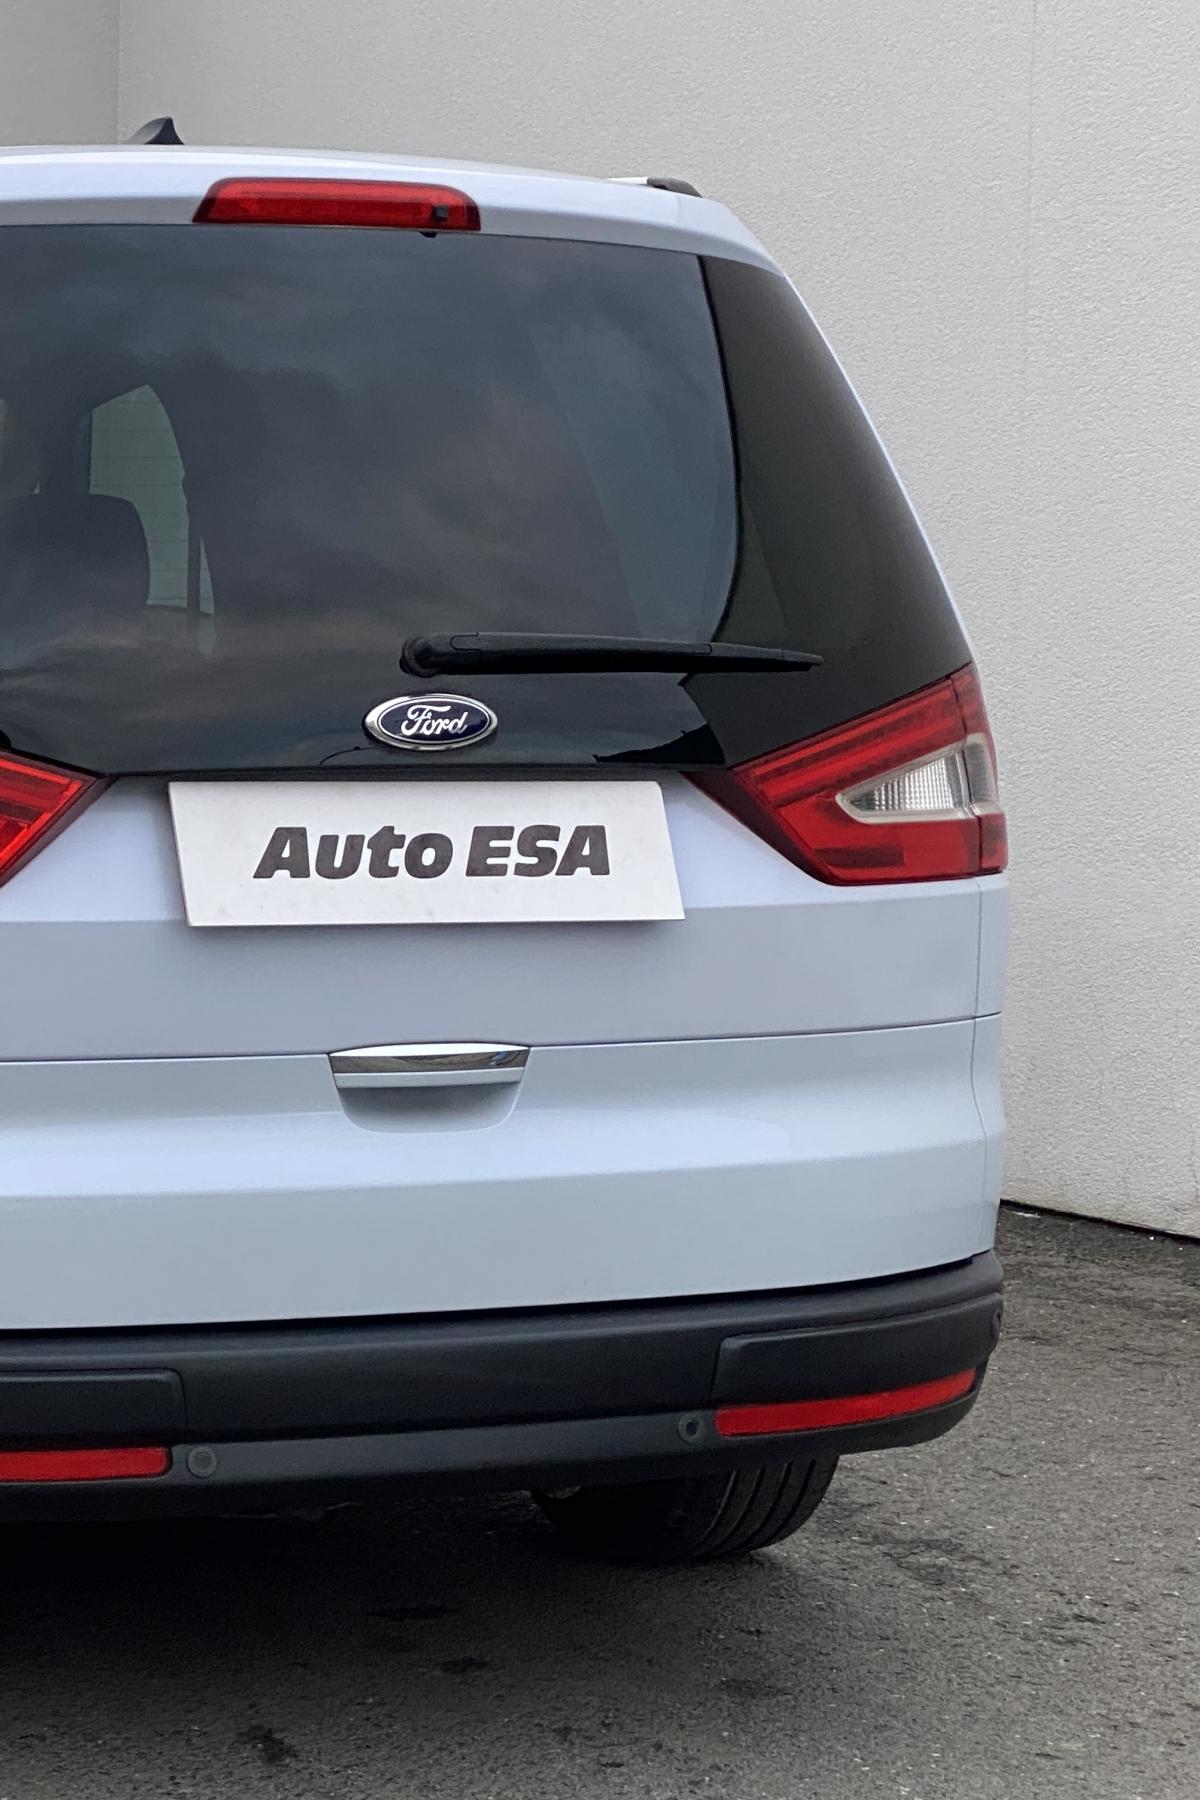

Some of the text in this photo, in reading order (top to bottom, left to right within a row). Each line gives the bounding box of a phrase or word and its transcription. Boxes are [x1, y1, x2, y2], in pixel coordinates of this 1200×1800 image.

[401, 705, 468, 736] Ford
[252, 824, 610, 879] Auto ESA
